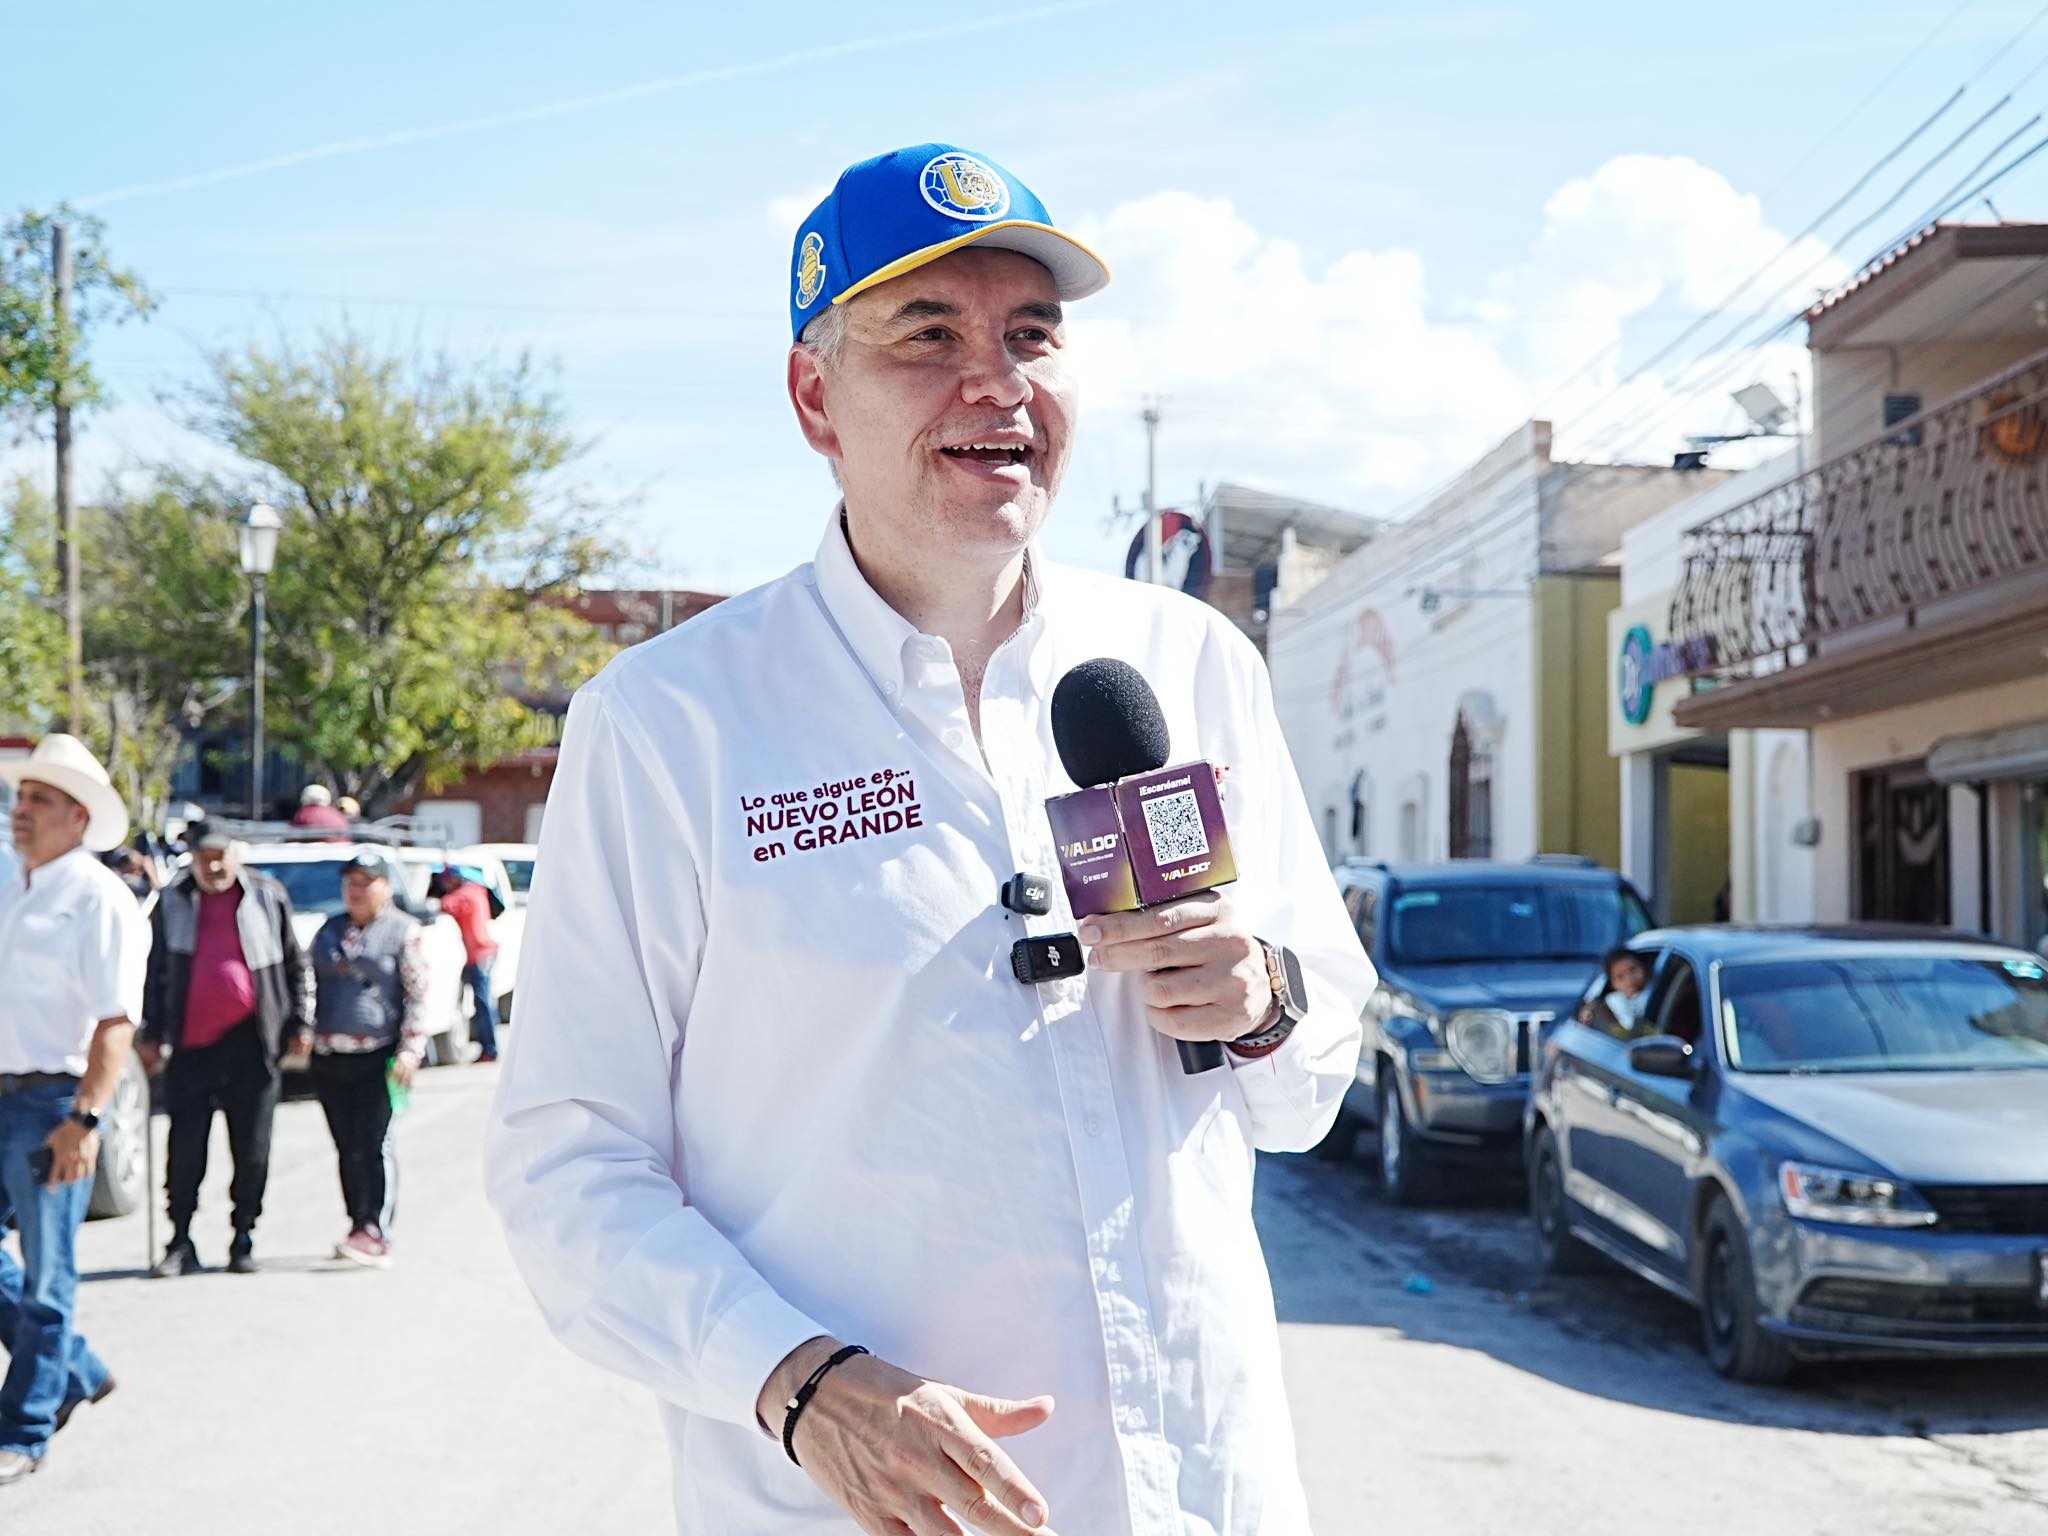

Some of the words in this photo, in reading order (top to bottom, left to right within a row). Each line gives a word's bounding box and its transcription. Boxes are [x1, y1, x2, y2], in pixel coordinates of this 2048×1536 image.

[741, 796, 766, 811] Lo
[771, 791, 808, 808] que
[812, 777, 866, 798] sigue
[747, 802, 838, 837] NUEVO
[847, 780, 915, 815] LEÓN
[754, 841, 786, 862] en
[793, 804, 923, 851] GRANDE
